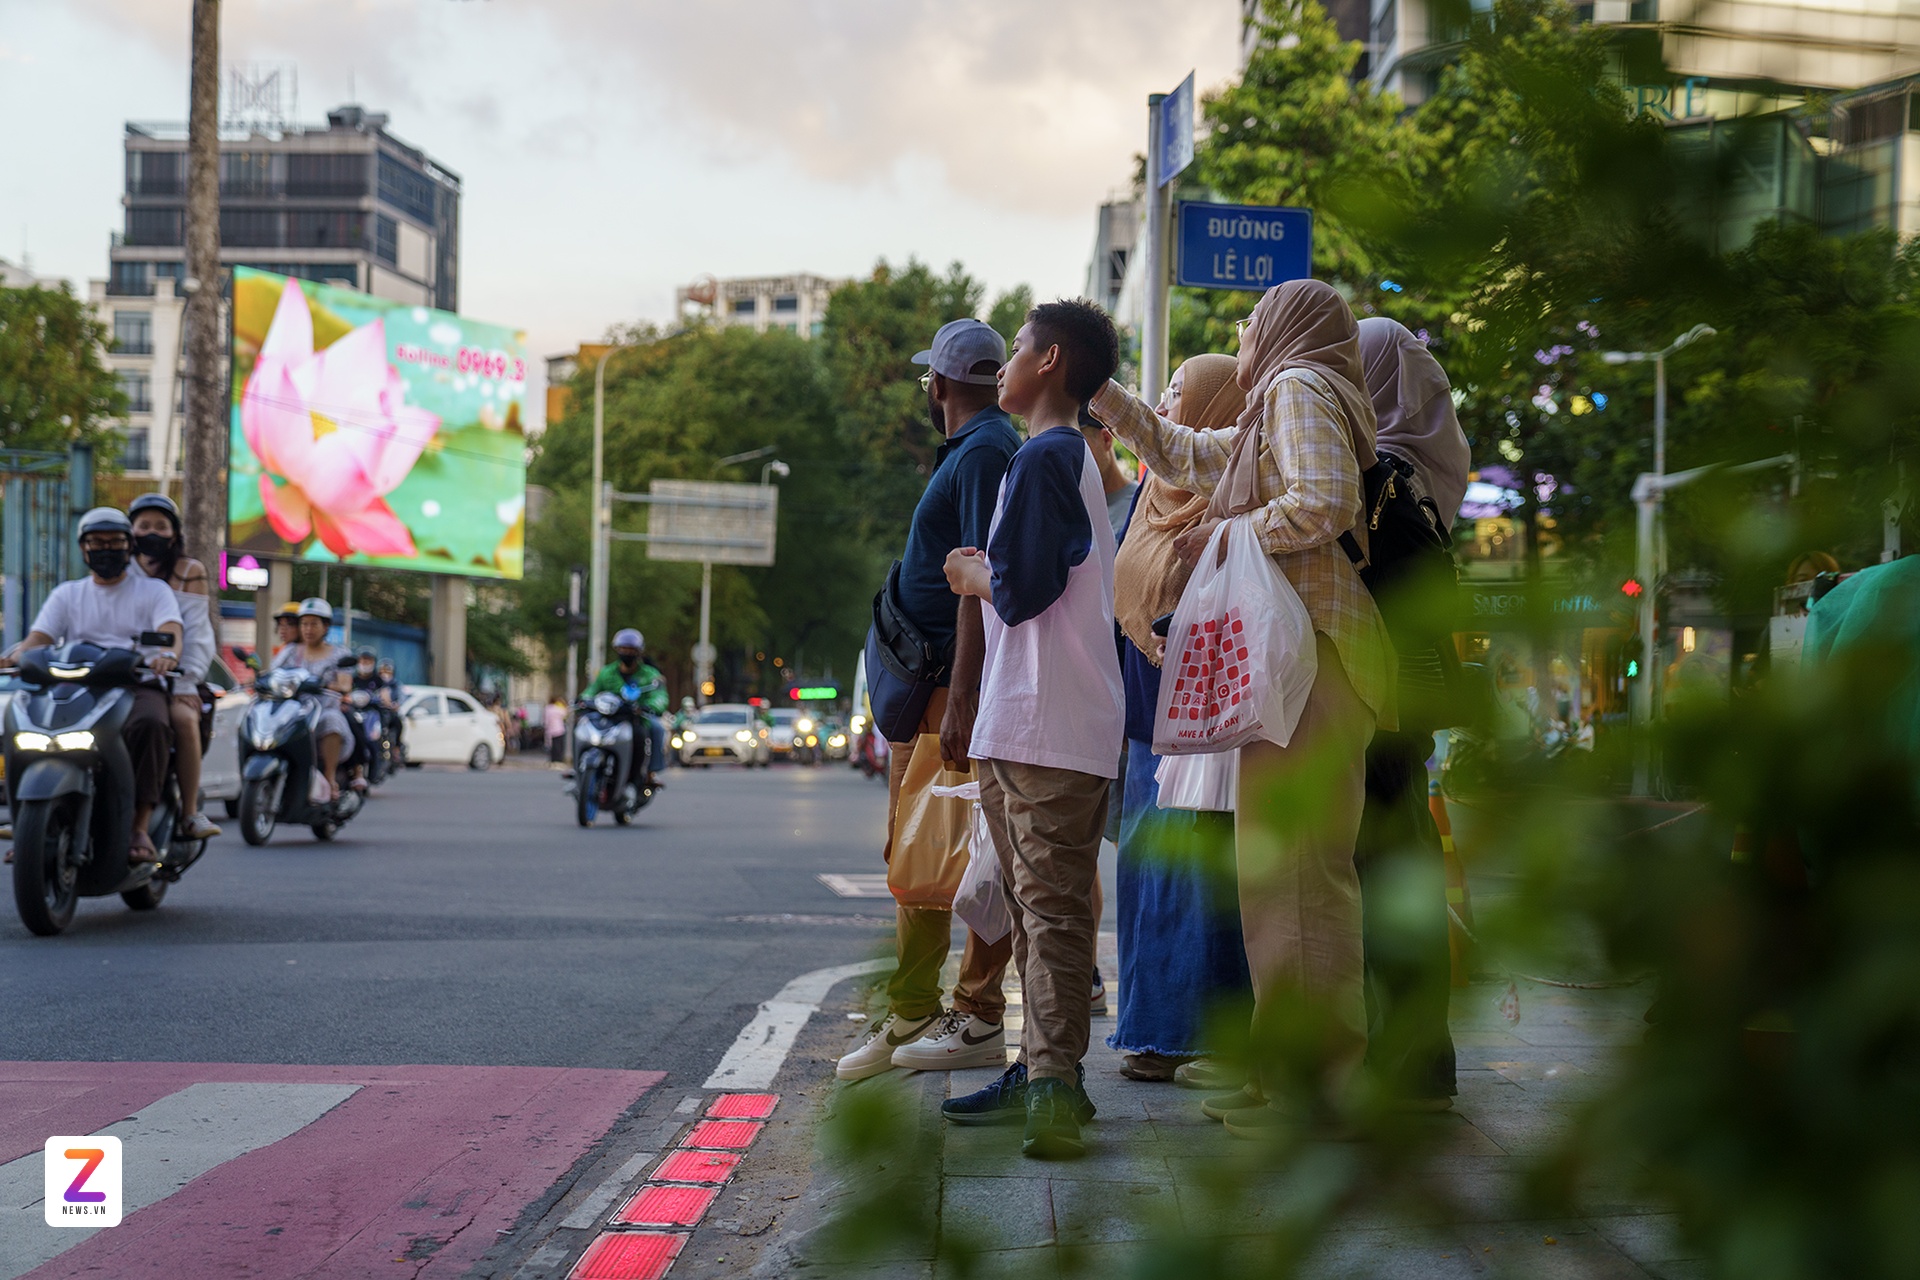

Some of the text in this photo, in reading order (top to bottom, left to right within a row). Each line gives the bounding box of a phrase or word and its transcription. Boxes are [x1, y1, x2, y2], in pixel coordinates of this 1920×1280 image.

[1207, 215, 1285, 241] ĐƯỜNG
[1213, 248, 1273, 286] LÊ LỢI
[1178, 730, 1197, 738] HAVE
[1224, 715, 1239, 728] DAY
